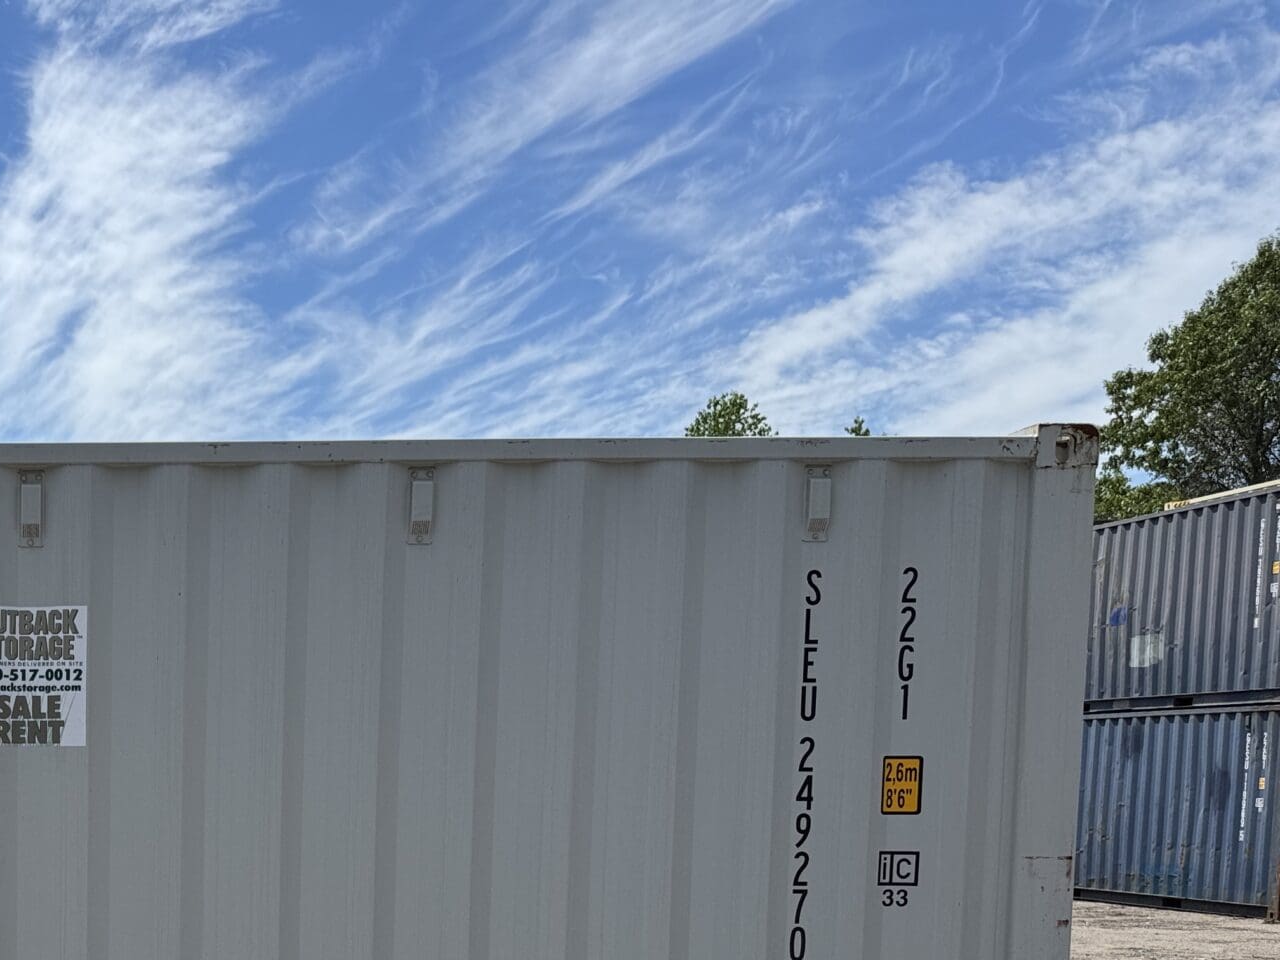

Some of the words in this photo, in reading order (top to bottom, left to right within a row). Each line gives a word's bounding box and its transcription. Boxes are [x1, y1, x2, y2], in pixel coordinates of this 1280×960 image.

[800, 569, 822, 721] SLEU
[897, 566, 918, 720] 22G1
[885, 762, 918, 785] 2,6m
[885, 788, 913, 808] 8'6"
[881, 888, 909, 907] 33
